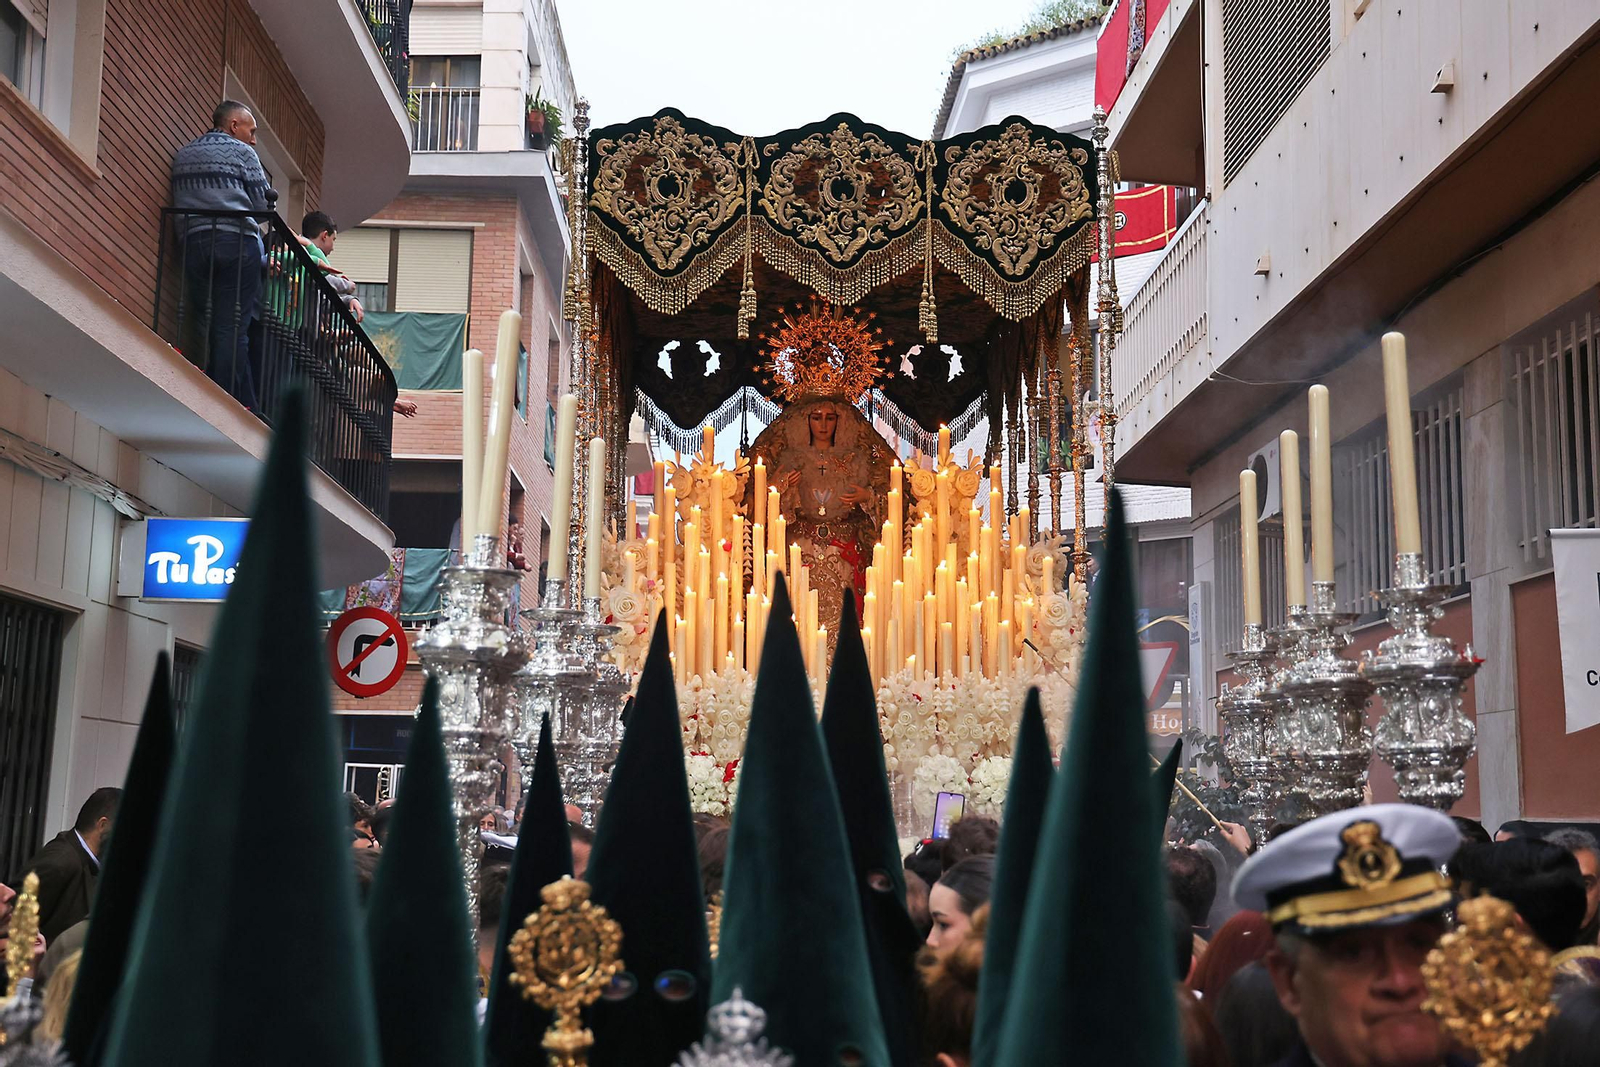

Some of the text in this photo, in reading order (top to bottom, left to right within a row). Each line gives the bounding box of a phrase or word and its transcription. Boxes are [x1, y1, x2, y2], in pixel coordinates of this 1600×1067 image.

[148, 534, 240, 585] Tu Pas
[1586, 669, 1600, 686] C
[1152, 713, 1183, 731] Ho
